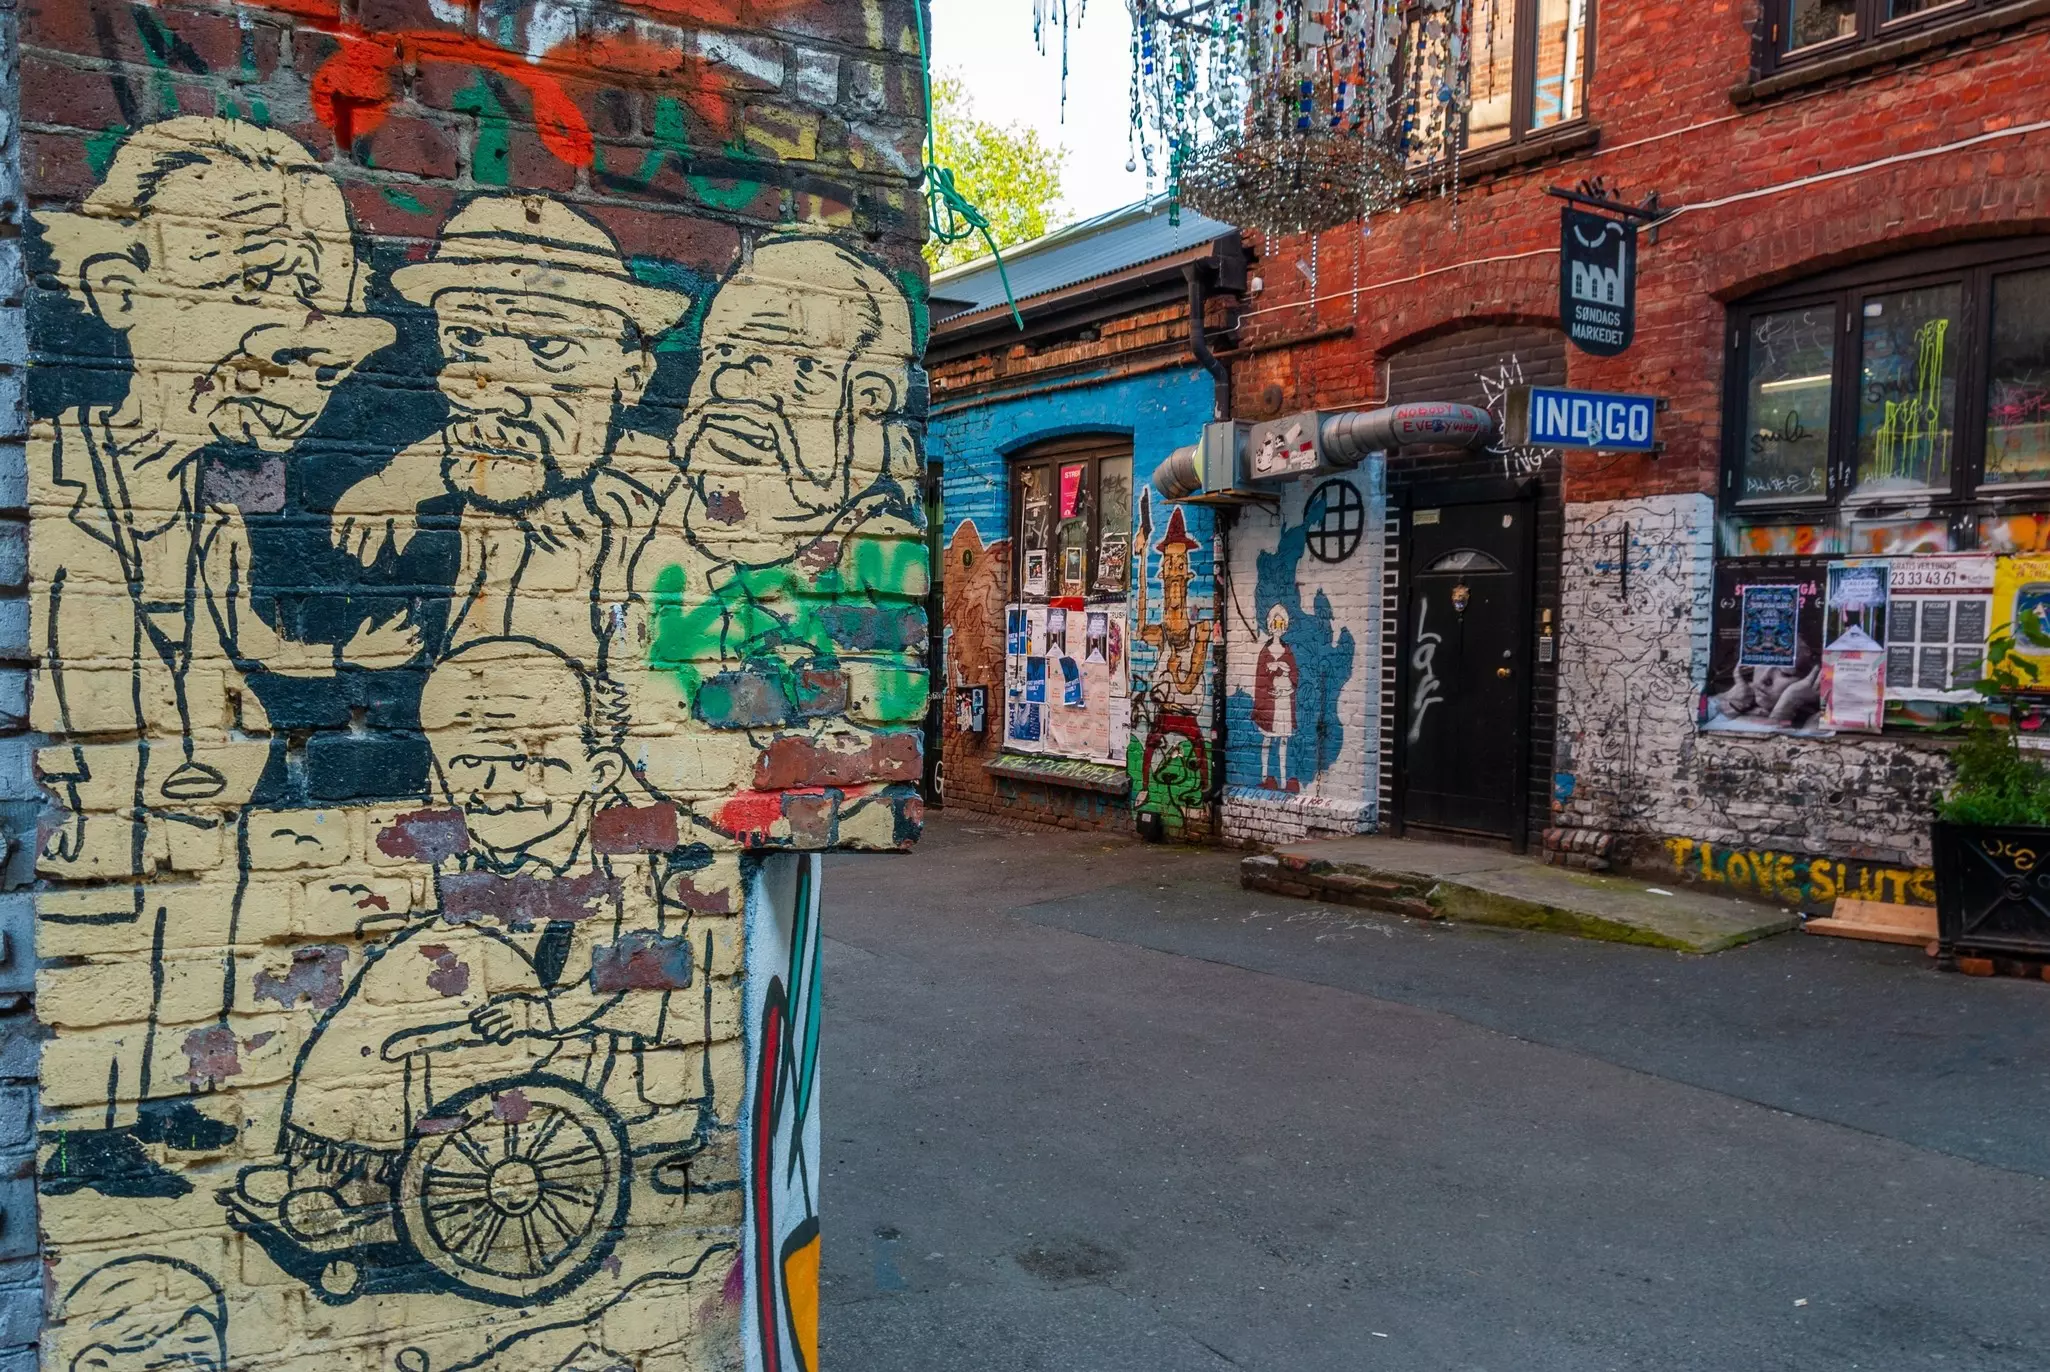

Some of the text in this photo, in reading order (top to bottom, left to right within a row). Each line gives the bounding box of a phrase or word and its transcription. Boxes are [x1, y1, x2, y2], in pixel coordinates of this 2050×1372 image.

[1575, 304, 1621, 326] SØNDAGS
[1572, 322, 1624, 345] MARKEDET
[1535, 395, 1649, 442] INDIGO
[1890, 571, 1905, 586] 23
[1907, 571, 1922, 586] 33
[1925, 571, 1941, 585] 43
[1699, 842, 1802, 905] LOVE
